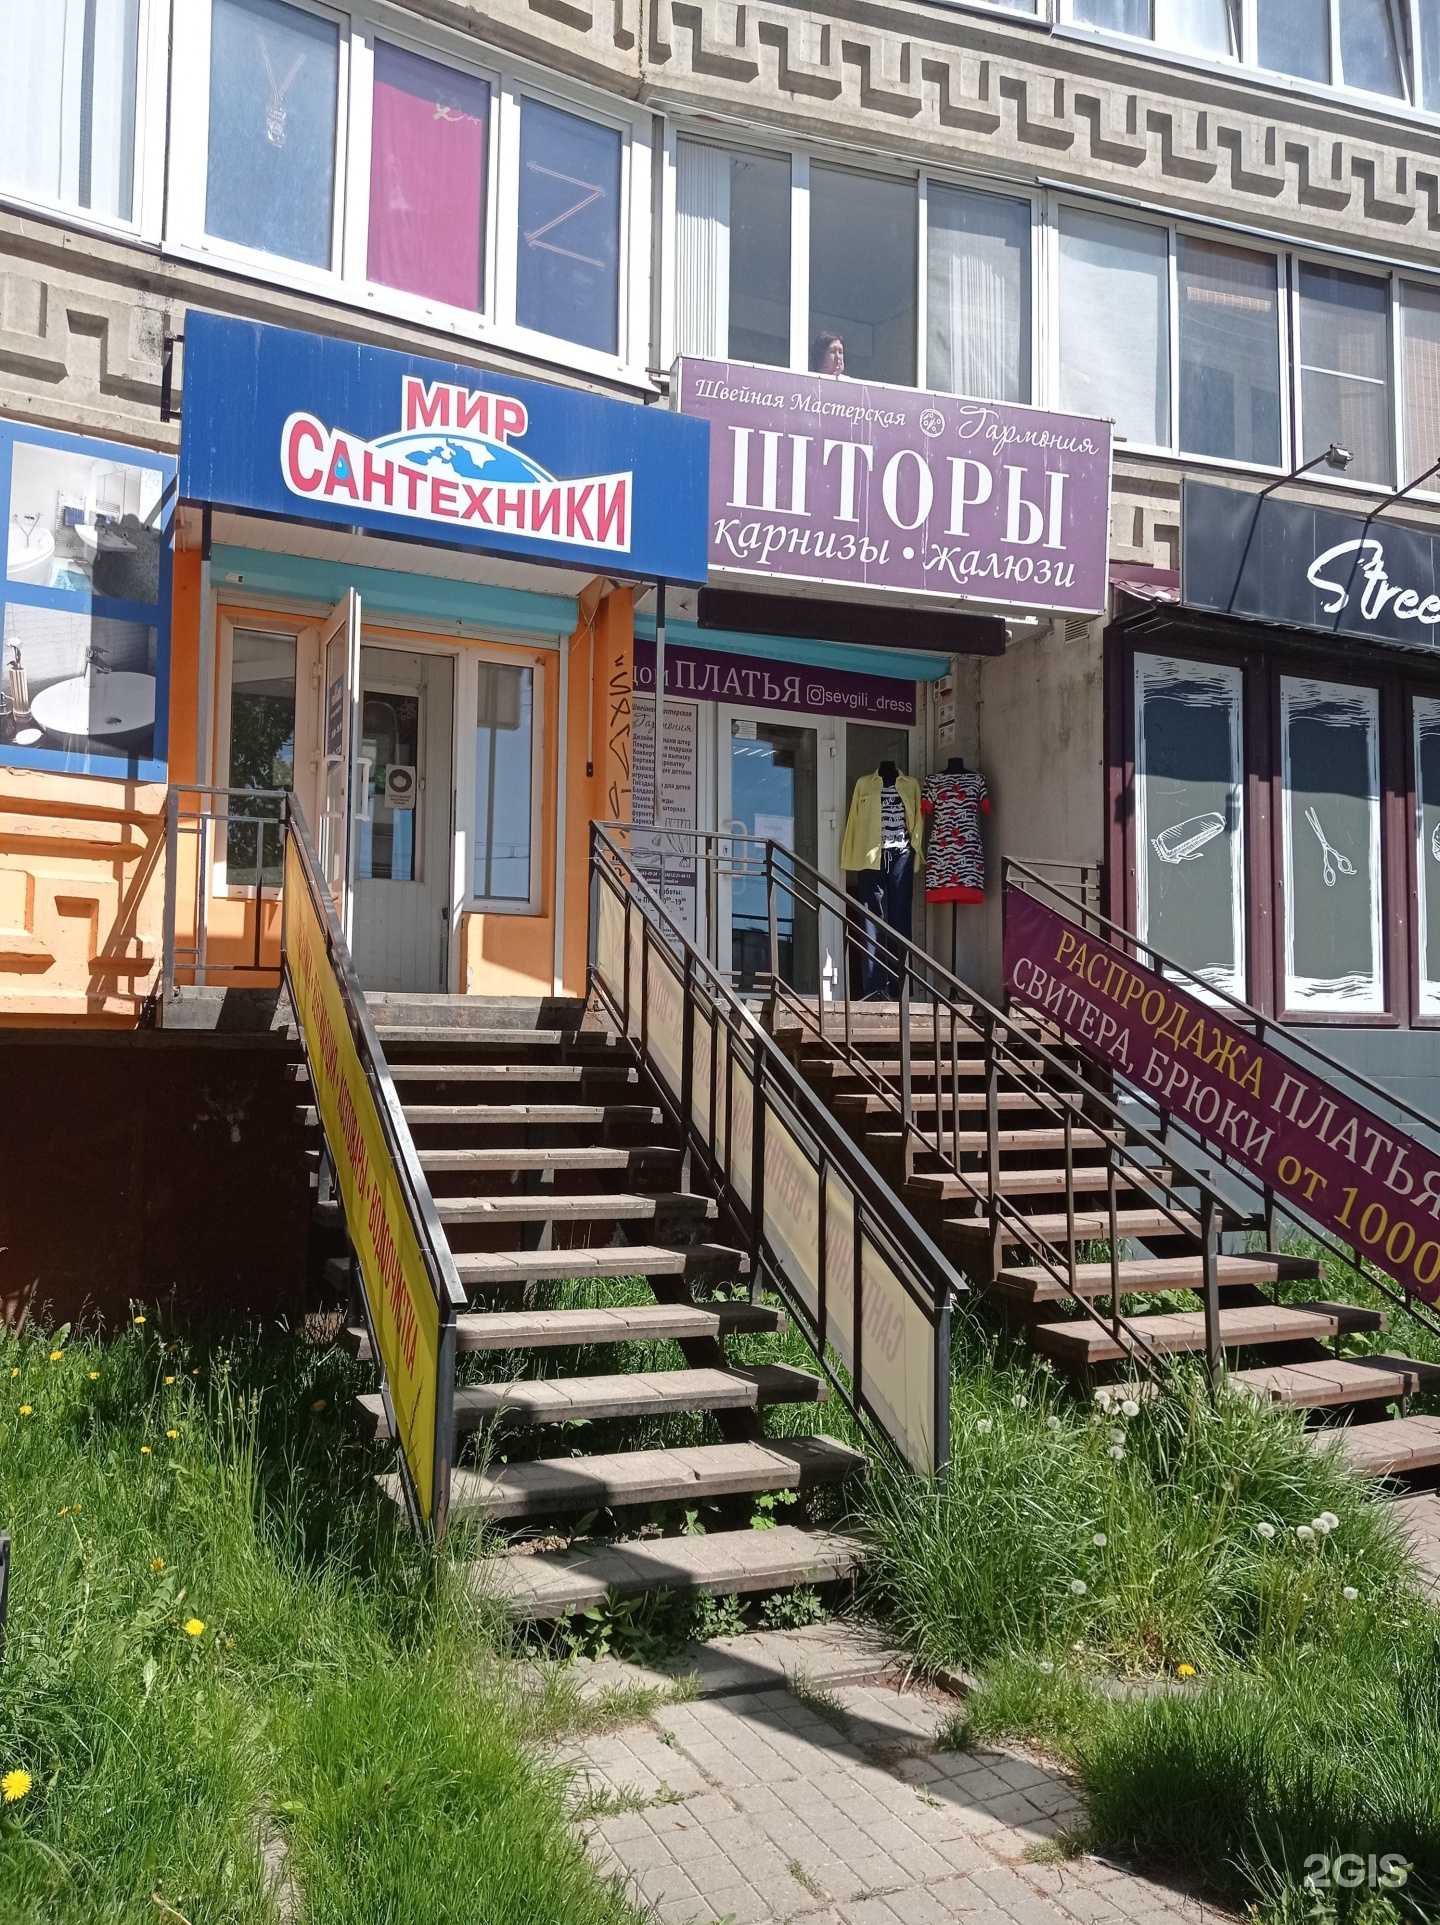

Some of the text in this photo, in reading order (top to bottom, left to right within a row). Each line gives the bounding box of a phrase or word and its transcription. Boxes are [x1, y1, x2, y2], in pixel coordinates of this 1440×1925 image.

[406, 378, 525, 442] МИР
[695, 379, 1100, 456] Швейная Мастерская Гармония
[287, 419, 627, 547] САНТЕХНИКИ
[725, 425, 1070, 550] ШТОРЫ
[923, 542, 1076, 588] жалюзи
[675, 659, 800, 704] ПЛАТЬЯ
[825, 690, 913, 713] sevgili_dress
[1053, 929, 1440, 1221] РАСПРОДАЖА ПЛАТЬЯ
[1142, 1047, 1275, 1166] БРЮКИ
[1277, 1155, 1328, 1203] от
[1333, 1186, 1440, 1285] 1000
[368, 1181, 418, 1380] ВОДООЧИСТКА
